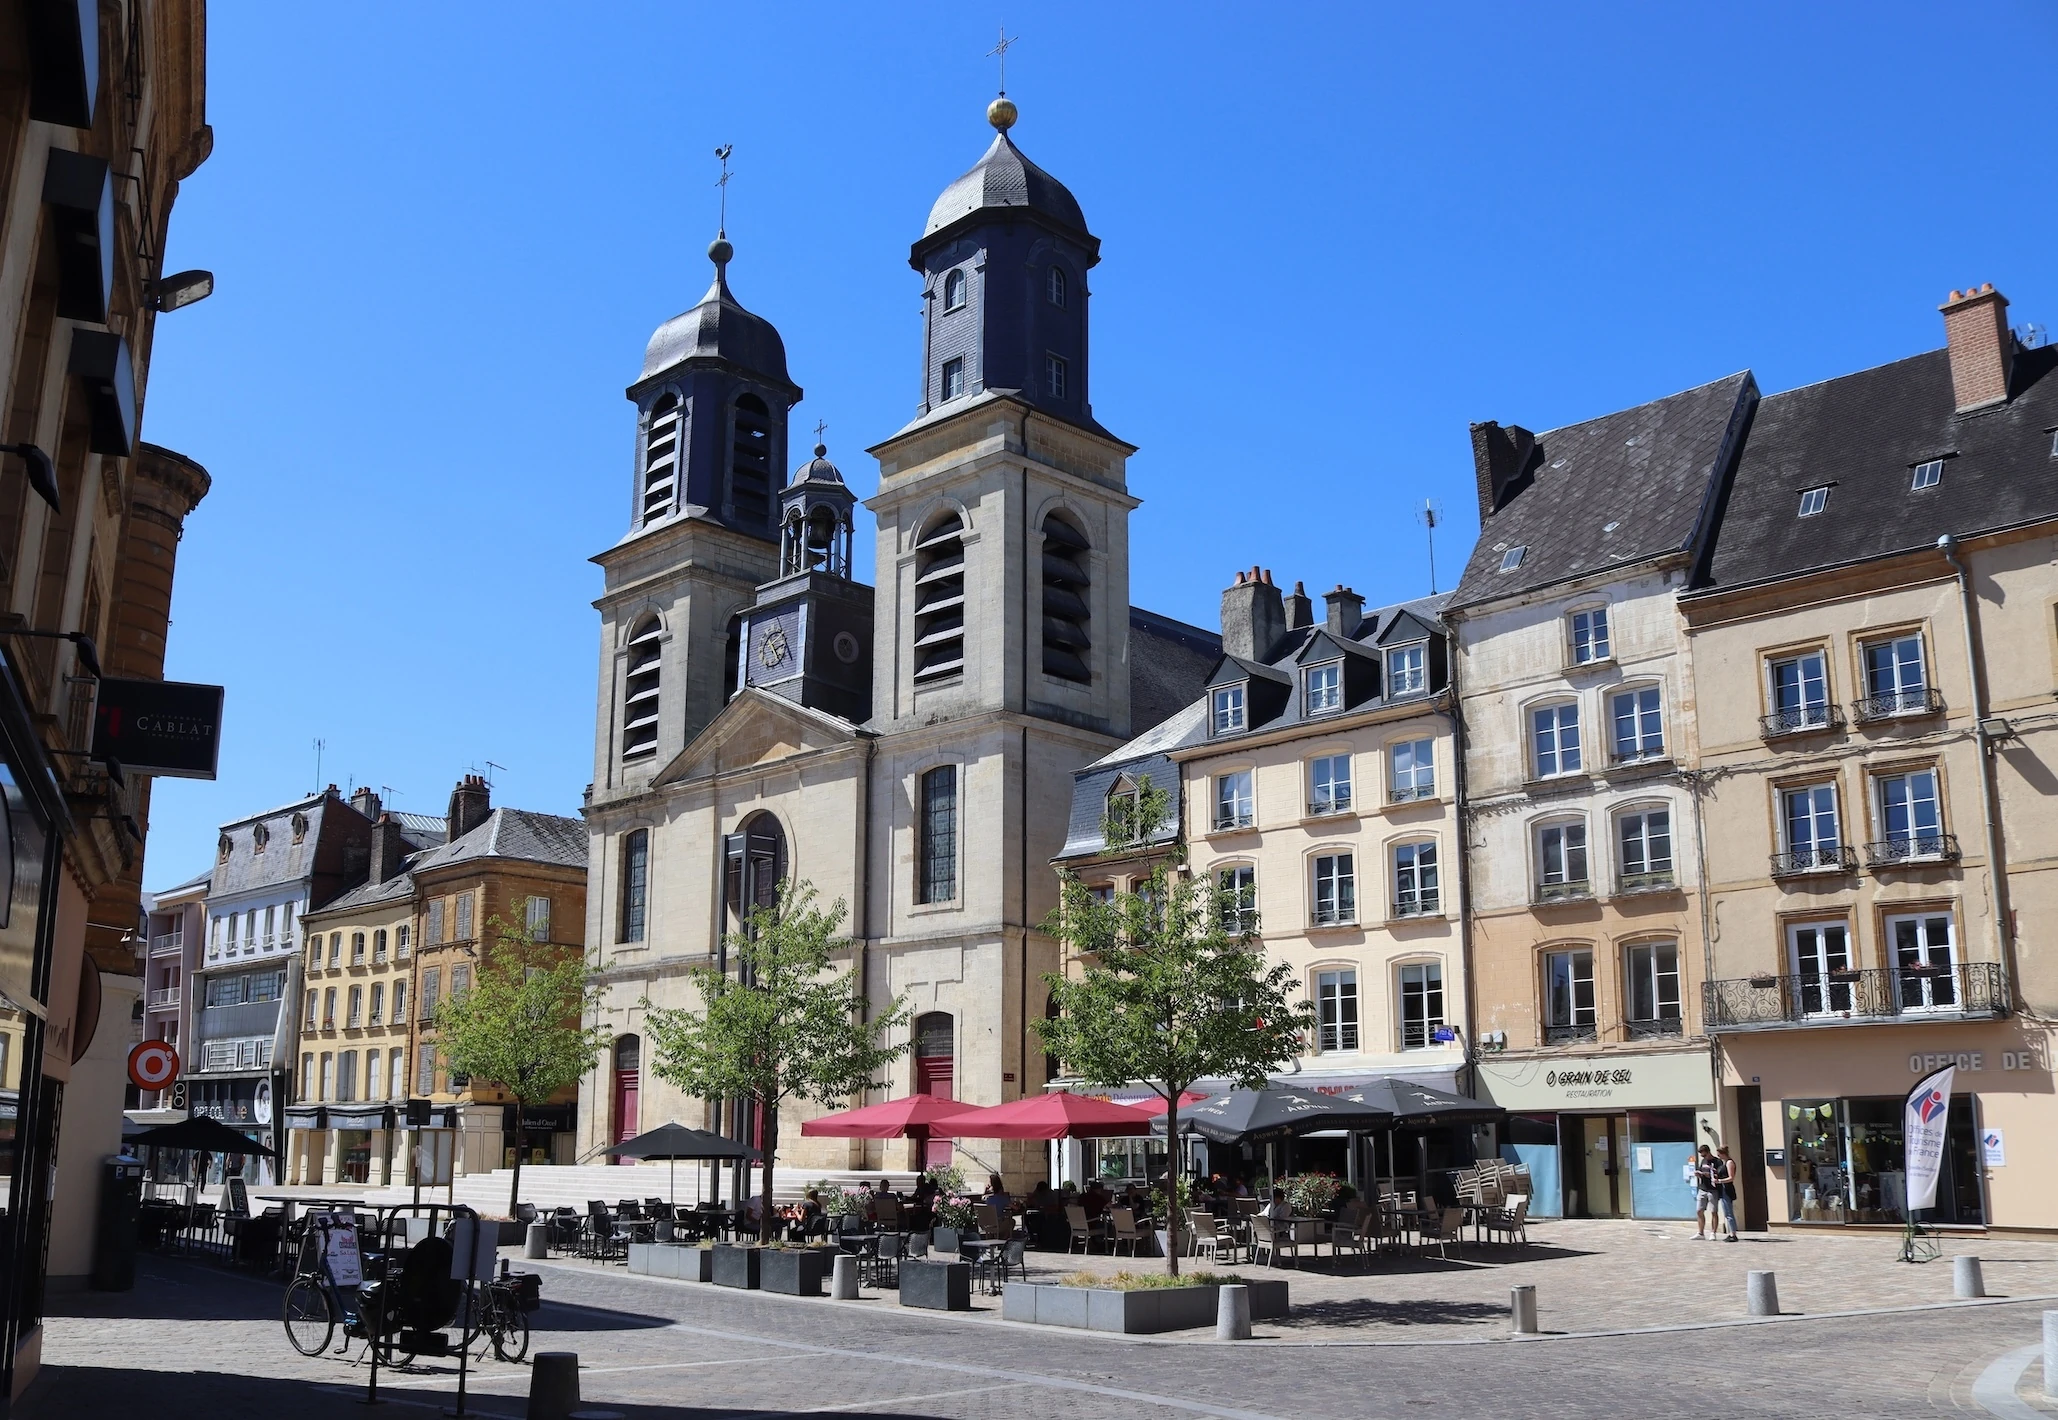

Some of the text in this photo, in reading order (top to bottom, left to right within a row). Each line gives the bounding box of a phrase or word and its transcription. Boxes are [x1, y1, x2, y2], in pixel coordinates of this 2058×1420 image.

[136, 716, 213, 736] CABLAT
[2003, 1052, 2032, 1071] DE
[1558, 1071, 1595, 1087] GRAIN
[1594, 1069, 1612, 1086] DE
[1611, 1069, 1633, 1085] SEL
[1566, 1089, 1613, 1098] RESTAURATION
